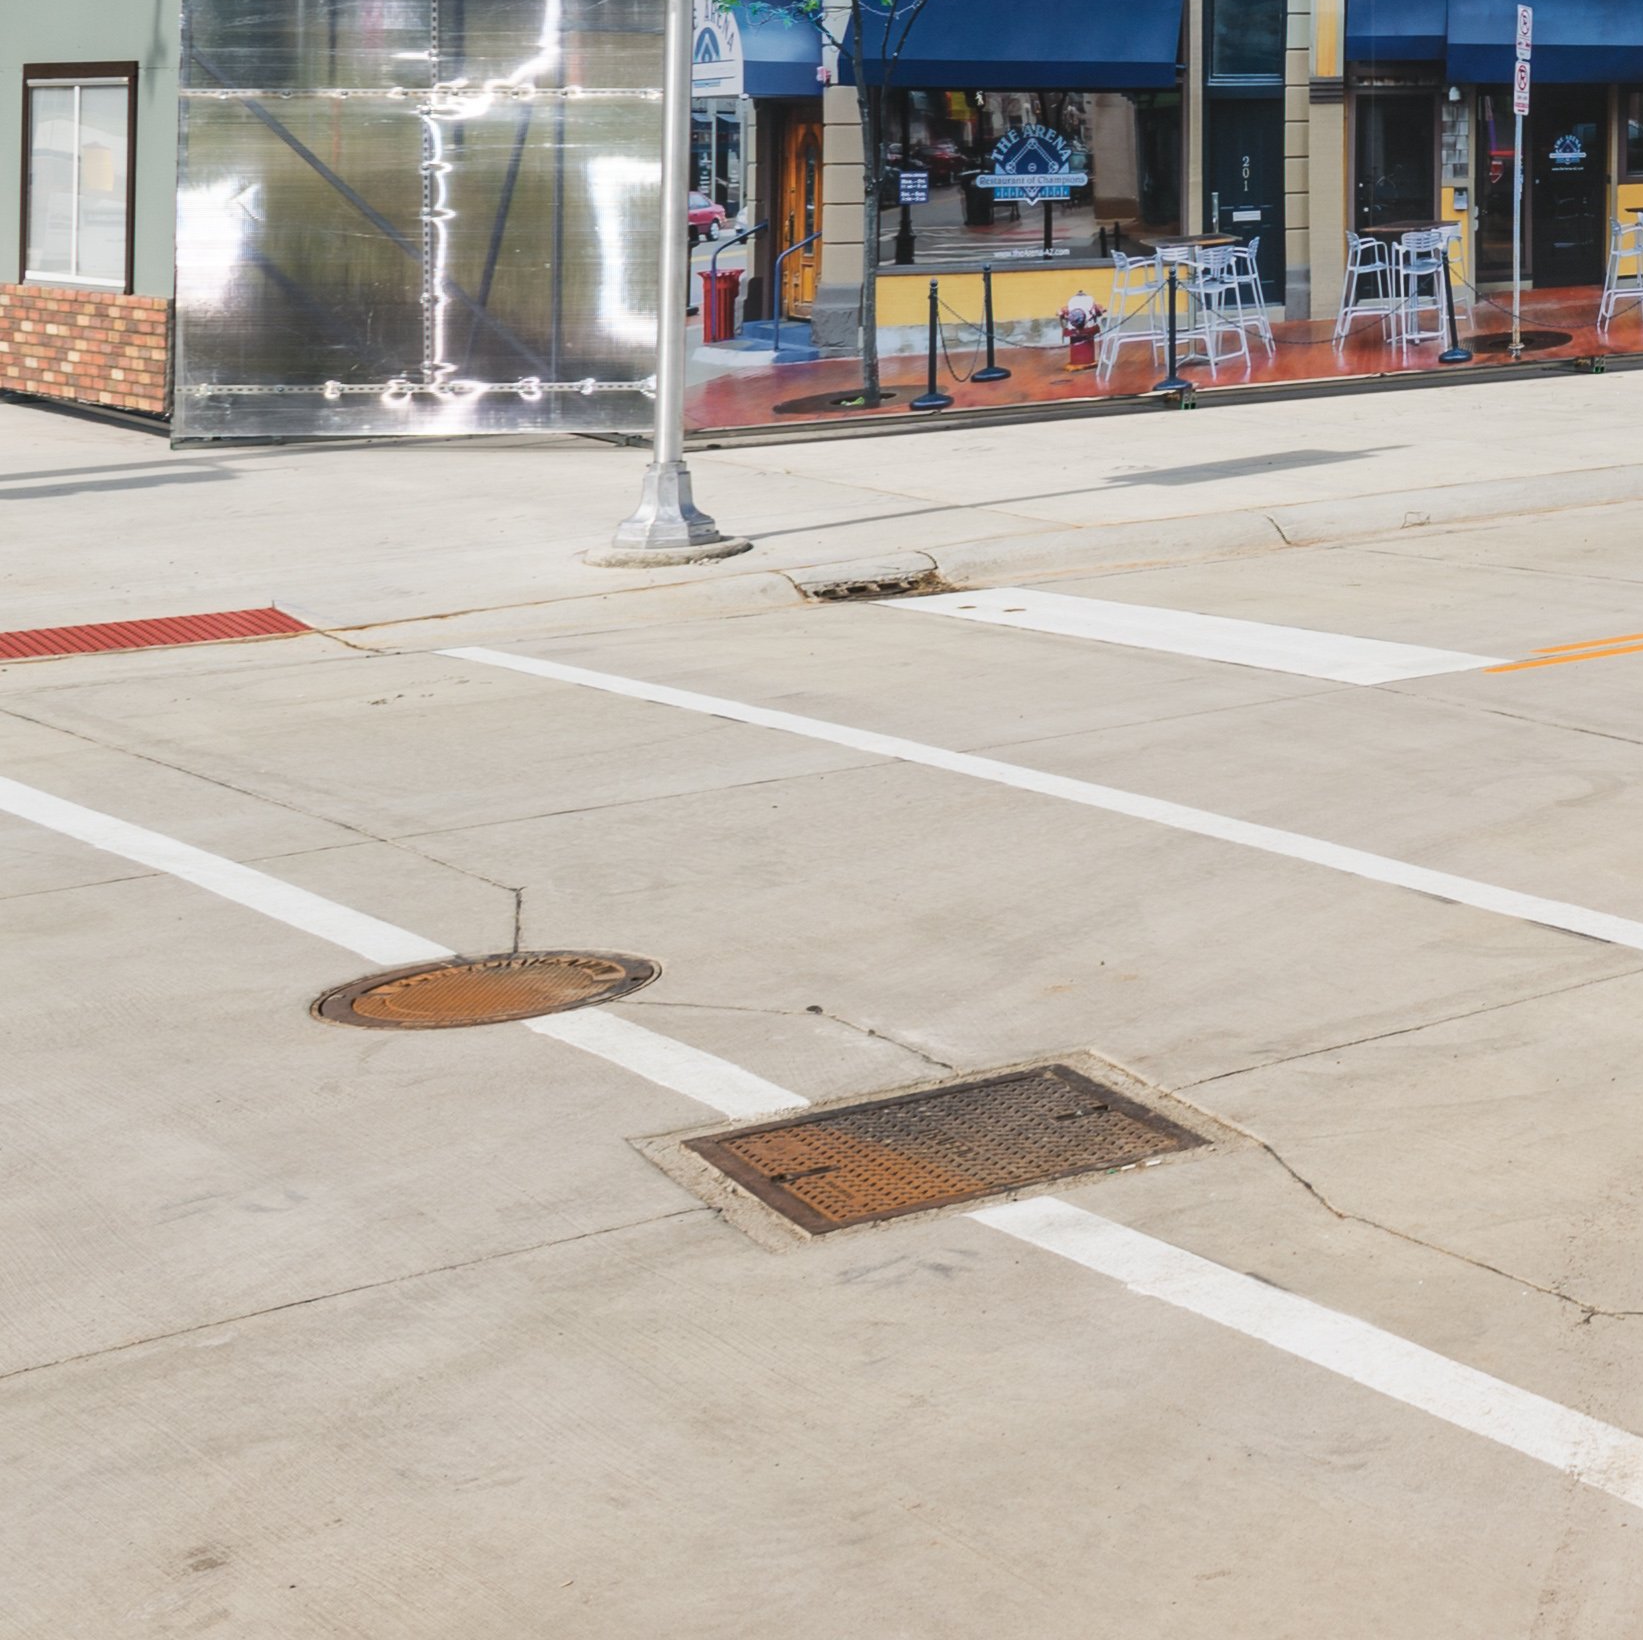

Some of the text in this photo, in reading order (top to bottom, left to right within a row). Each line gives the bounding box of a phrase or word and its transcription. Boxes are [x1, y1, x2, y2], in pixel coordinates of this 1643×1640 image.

[991, 123, 1072, 162] THE ARENA
[979, 175, 1085, 186] Restaurant of Champions
[1242, 155, 1250, 192] 201
